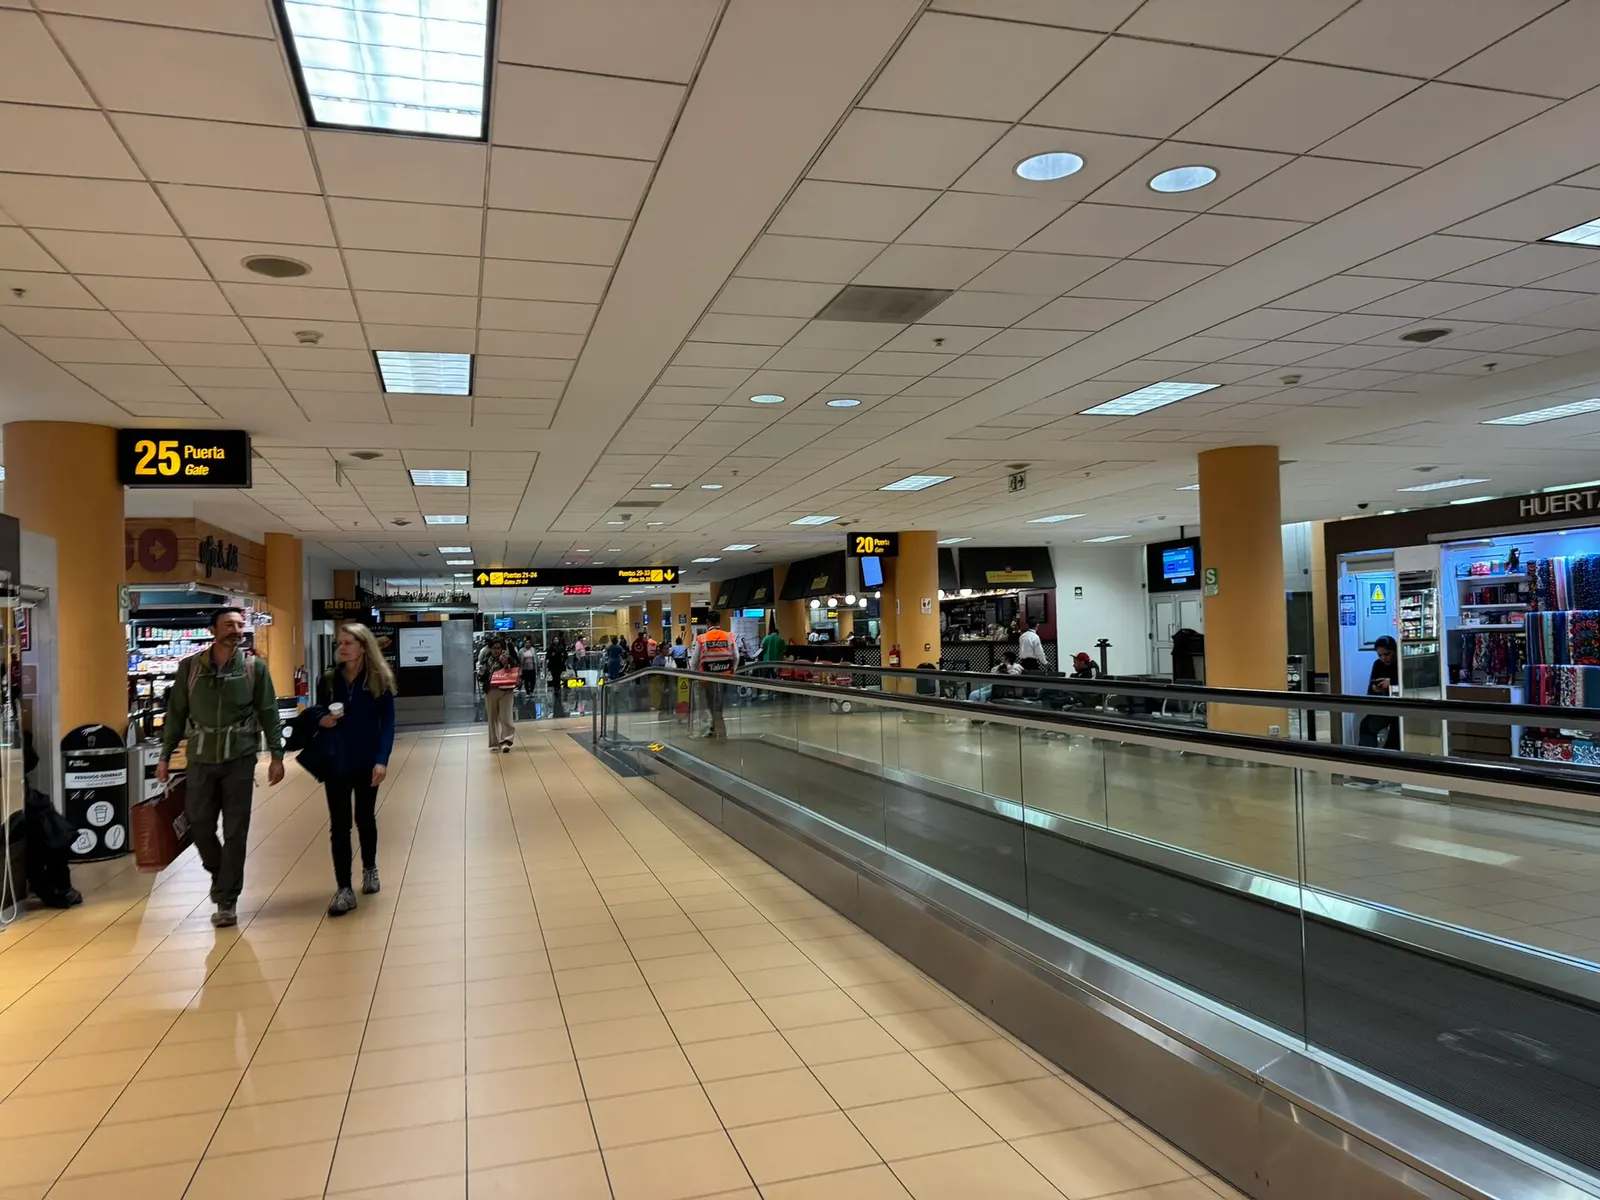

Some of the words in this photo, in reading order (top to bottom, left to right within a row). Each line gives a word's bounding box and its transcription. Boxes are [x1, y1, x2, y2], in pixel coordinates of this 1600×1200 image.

[134, 440, 181, 476] 25
[184, 445, 225, 459] Puerta
[185, 463, 210, 476] Gate
[1519, 490, 1600, 517] HUERT
[856, 536, 874, 553] 20
[874, 538, 890, 546] Puerta
